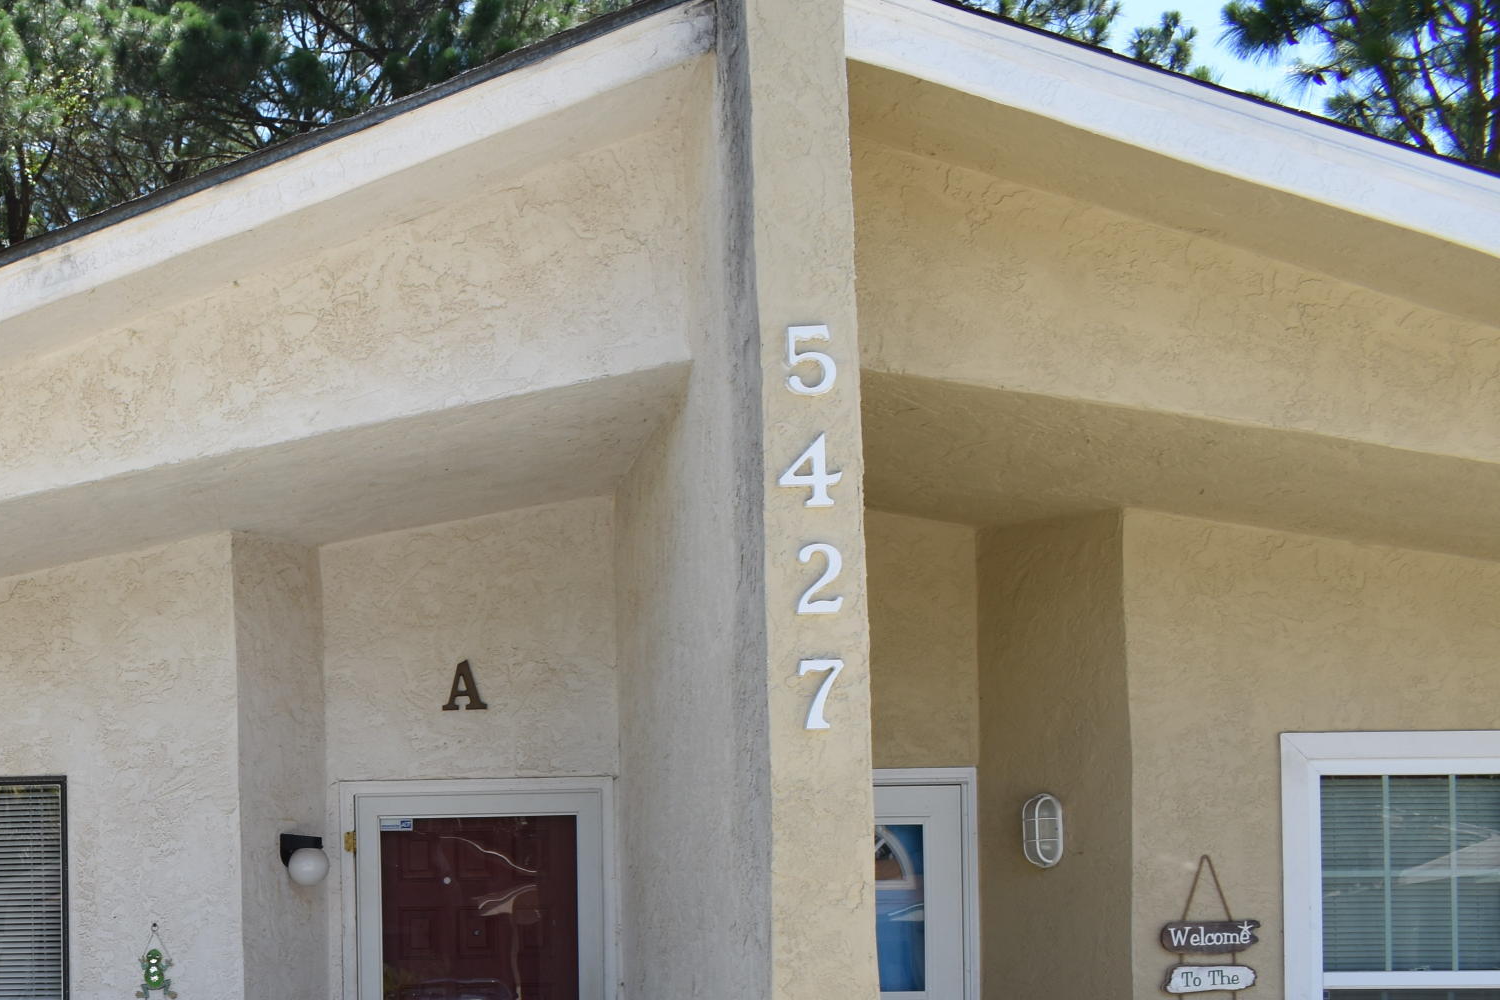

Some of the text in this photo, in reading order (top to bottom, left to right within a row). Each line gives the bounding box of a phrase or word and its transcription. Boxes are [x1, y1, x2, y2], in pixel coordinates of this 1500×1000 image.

[777, 324, 845, 730] 5427
[442, 659, 488, 711] A
[1168, 925, 1251, 947] Welcome
[1181, 969, 1240, 987] To The
